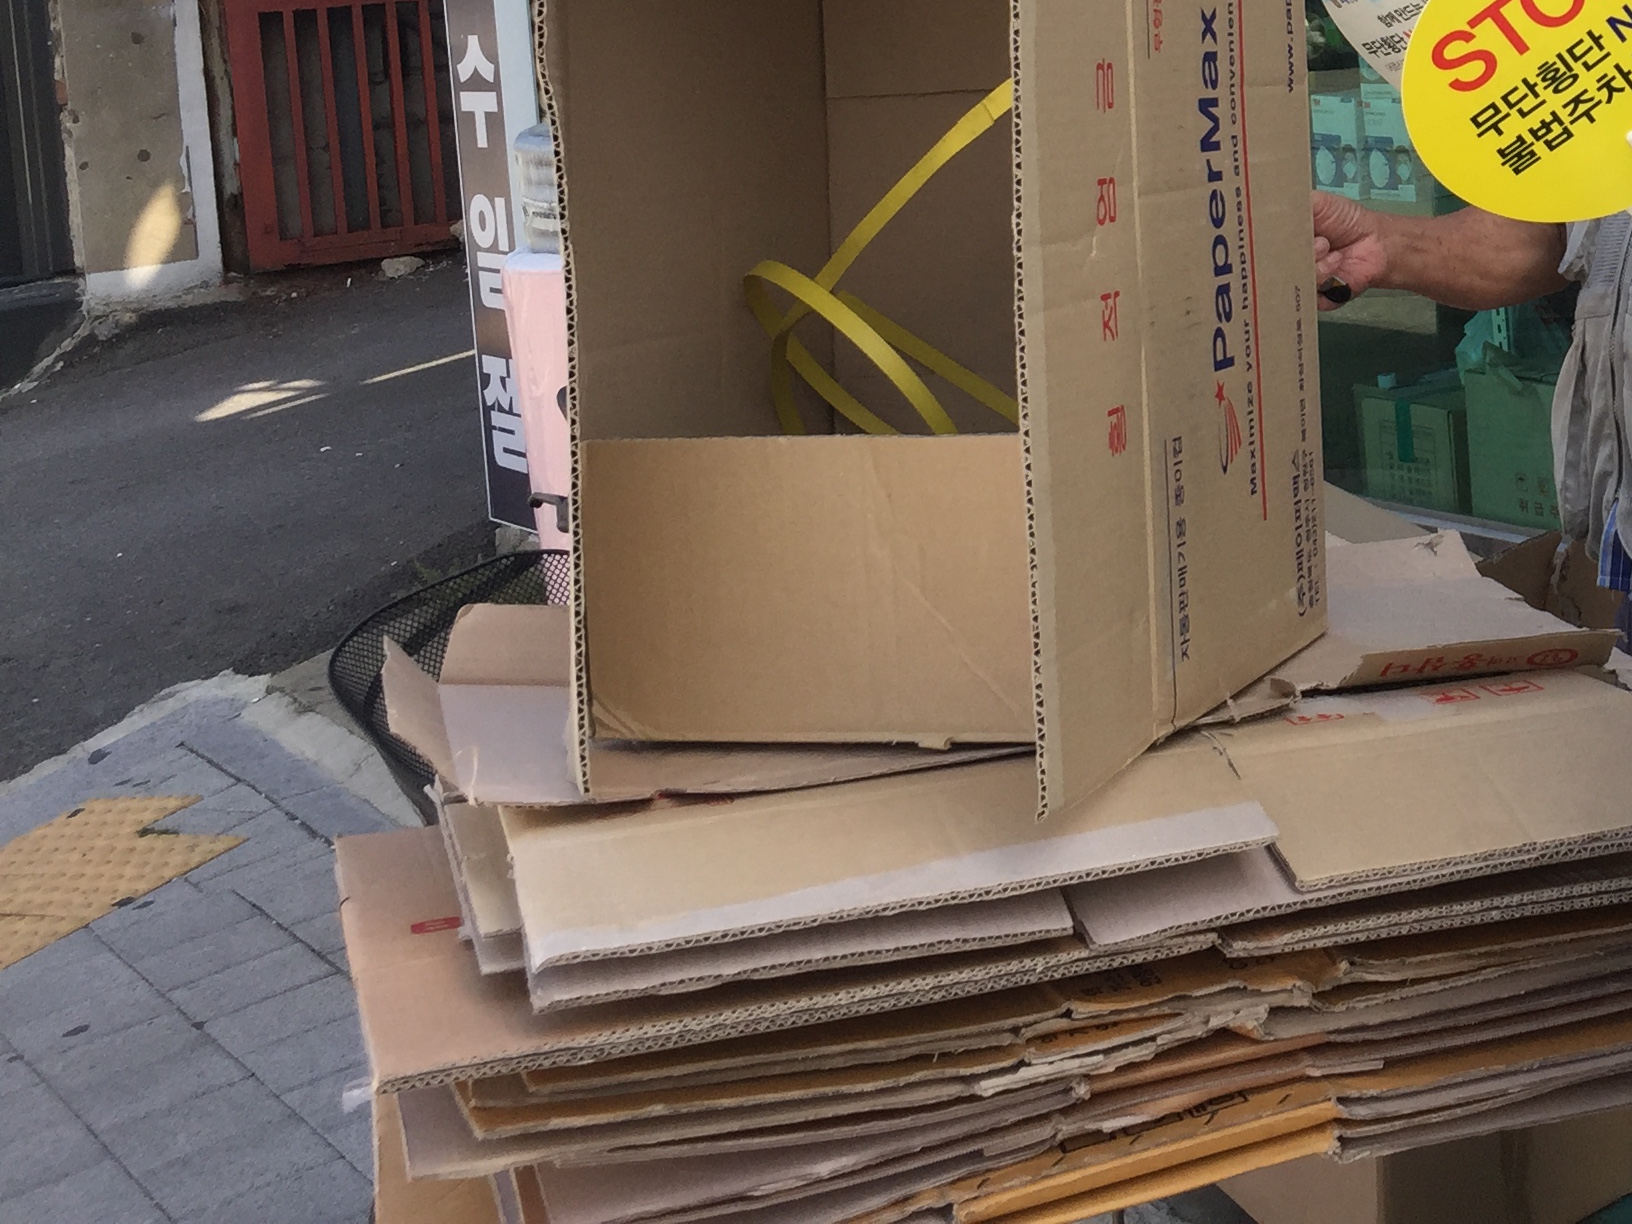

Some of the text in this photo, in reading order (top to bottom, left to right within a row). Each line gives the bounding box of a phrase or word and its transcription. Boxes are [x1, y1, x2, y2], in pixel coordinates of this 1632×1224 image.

[1470, 29, 1611, 138] 무단횡단
[1198, 6, 1235, 372] PaperMax
[1231, 134, 1241, 177] and
[1235, 186, 1250, 310] happiness
[1242, 319, 1253, 373] your
[1246, 380, 1258, 496] Maximize
